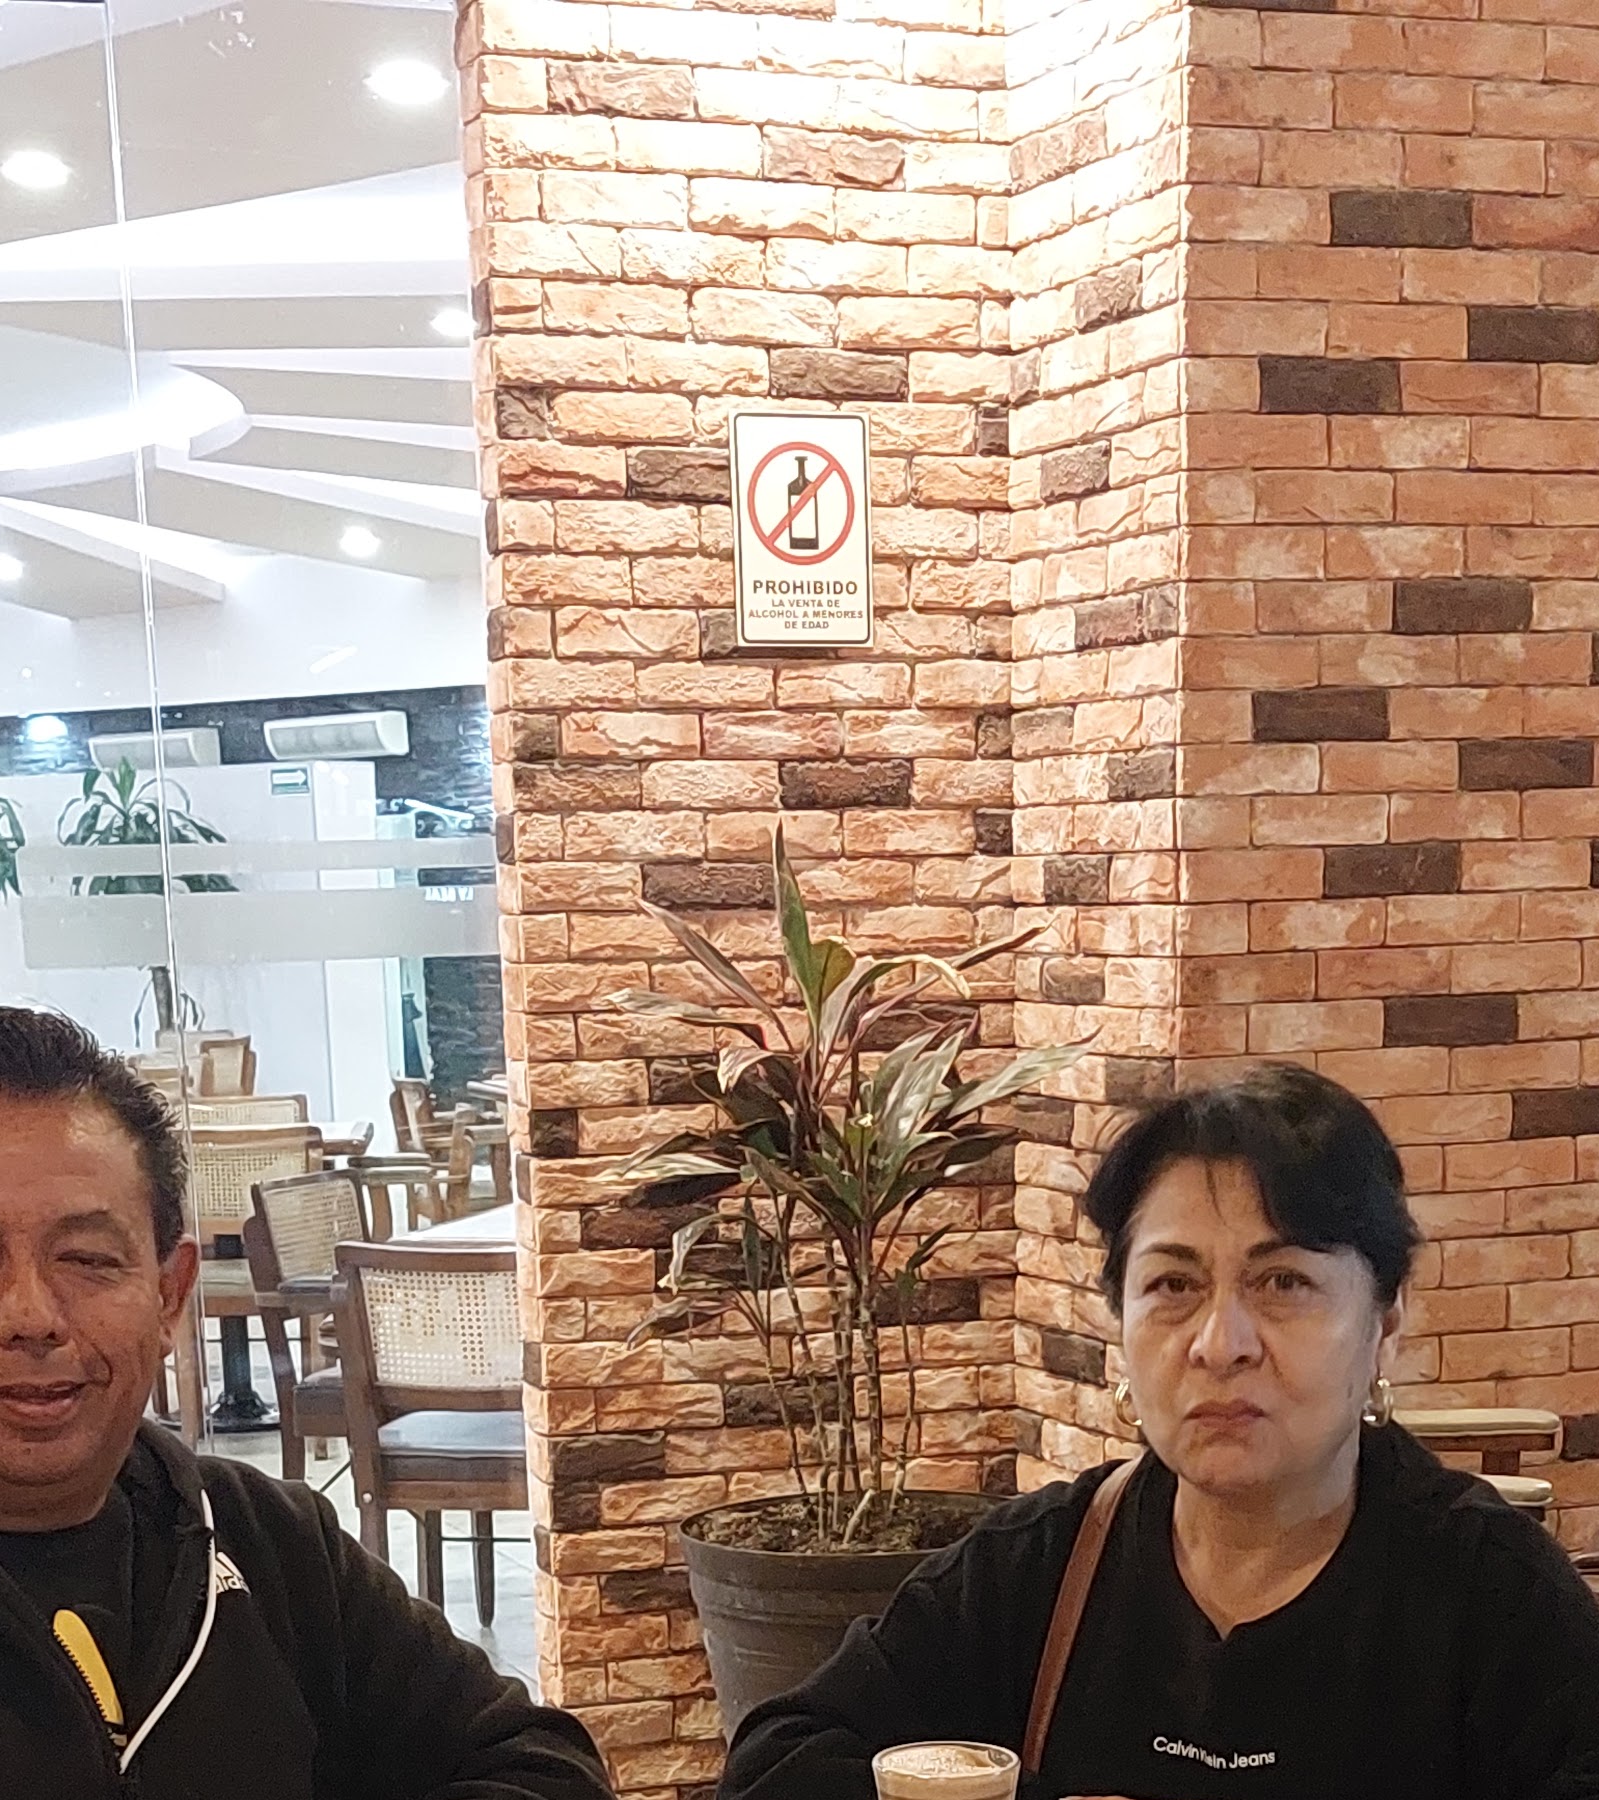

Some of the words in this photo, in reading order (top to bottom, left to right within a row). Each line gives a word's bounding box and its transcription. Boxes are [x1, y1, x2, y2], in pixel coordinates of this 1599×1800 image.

[753, 580, 857, 595] PROHIBIDO
[771, 599, 785, 608] LA
[788, 599, 824, 608] VENTA
[827, 600, 840, 608] DE
[748, 609, 799, 618] ALCOHOL
[802, 610, 810, 618] A
[812, 610, 863, 619] MENORES
[784, 621, 798, 629] DE
[802, 621, 829, 629] EDAD
[1153, 1736, 1199, 1760] Calvin
[1229, 1752, 1275, 1768] Jeans
